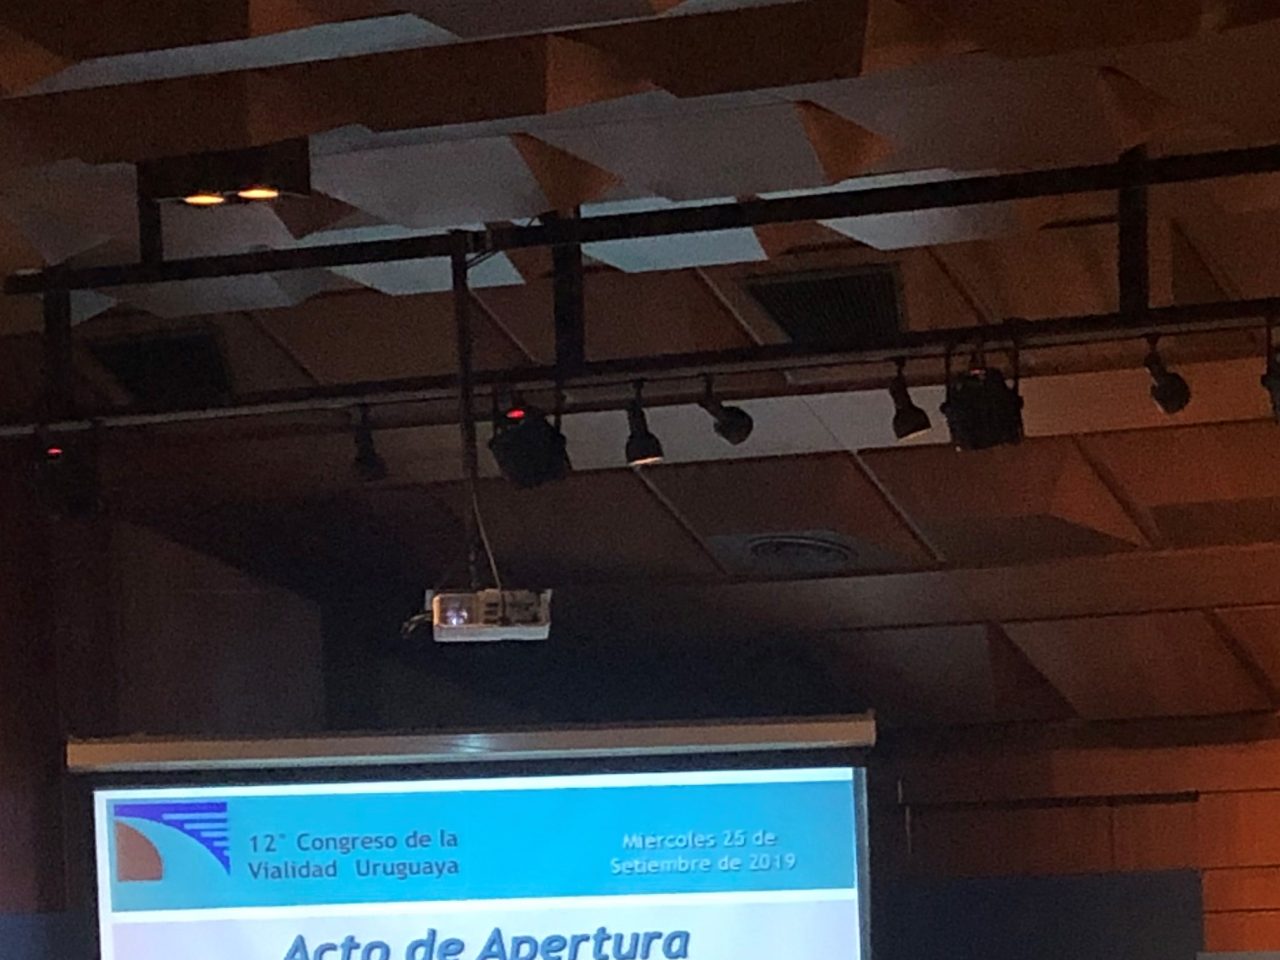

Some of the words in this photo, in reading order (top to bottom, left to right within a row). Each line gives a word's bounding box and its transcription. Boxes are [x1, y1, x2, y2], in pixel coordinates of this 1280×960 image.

[296, 832, 398, 855] Congreso
[405, 830, 434, 849] de
[440, 829, 459, 848] la
[723, 829, 746, 848] 25
[752, 829, 778, 847] de
[248, 859, 338, 880] Vialidad
[355, 858, 460, 879] Uruguaya
[610, 855, 713, 876] Setiembre
[717, 854, 742, 872] de
[749, 852, 797, 871] 2019
